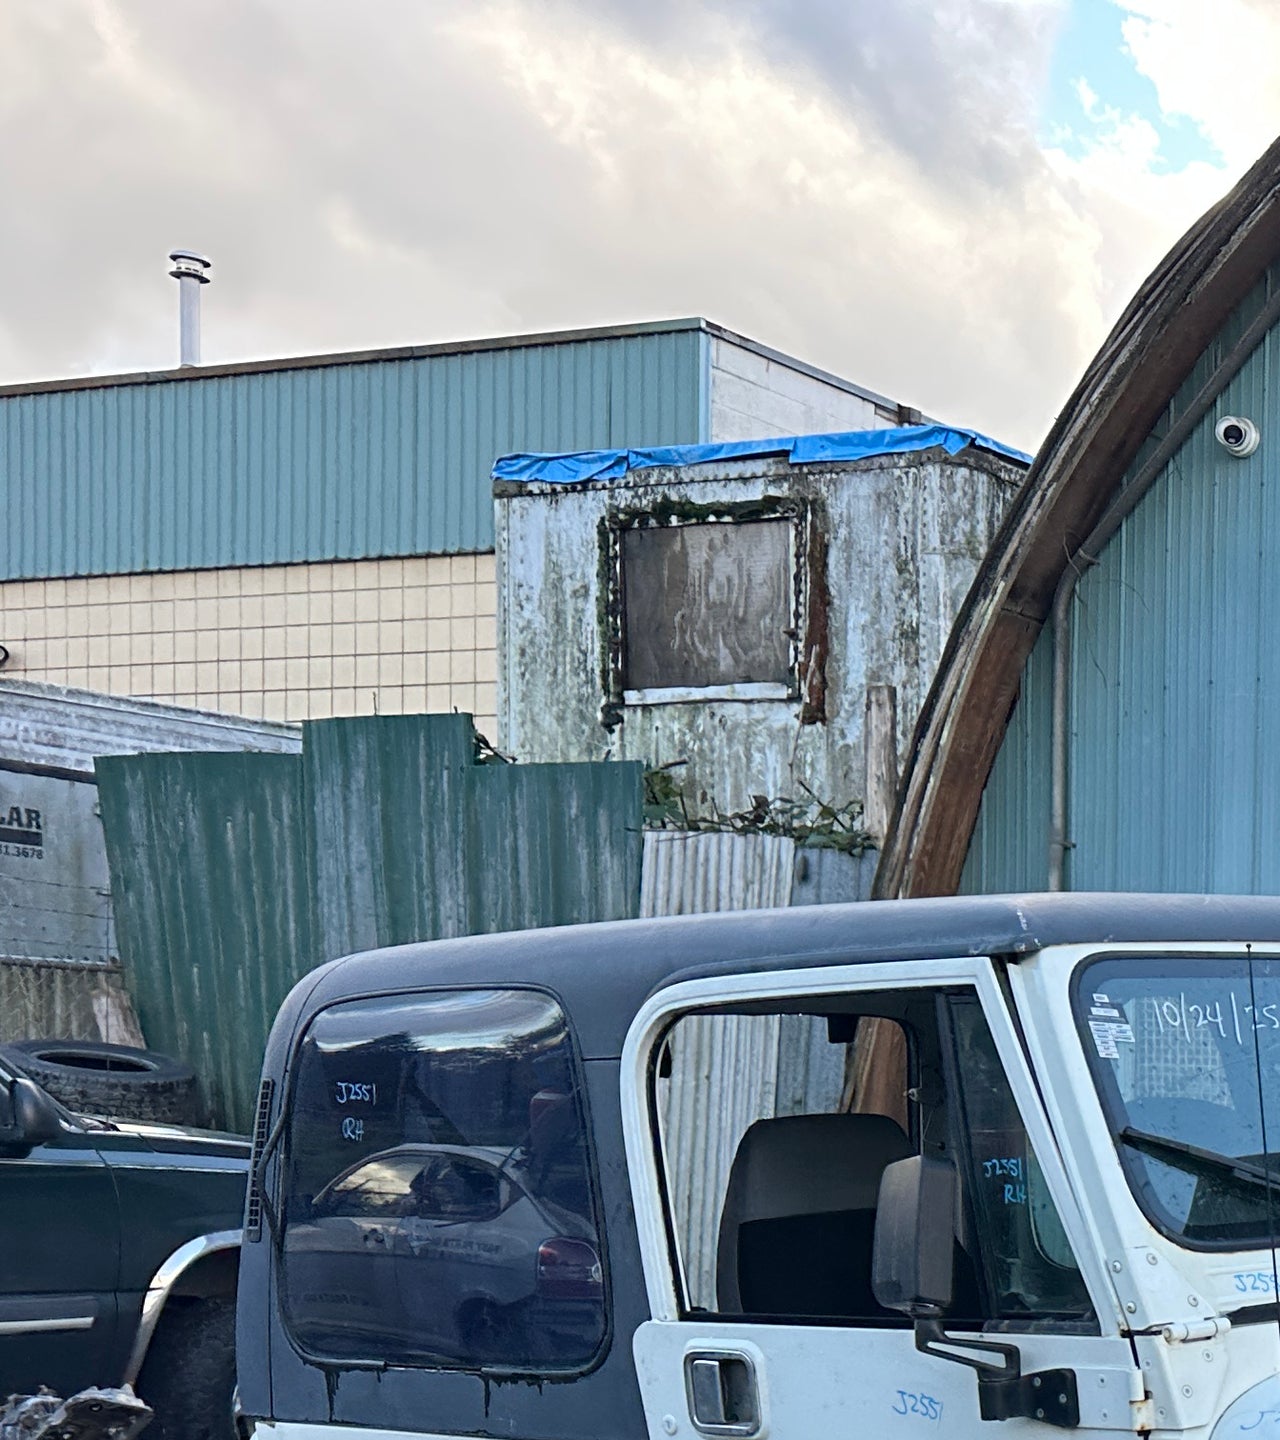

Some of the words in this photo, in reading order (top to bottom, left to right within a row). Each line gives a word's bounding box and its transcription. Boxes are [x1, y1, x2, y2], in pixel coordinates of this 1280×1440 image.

[0, 806, 42, 831] AR
[335, 1081, 376, 1106] J2551
[342, 1117, 365, 1141] RH
[982, 1156, 1023, 1181] J2551
[891, 1390, 943, 1431] J2551
